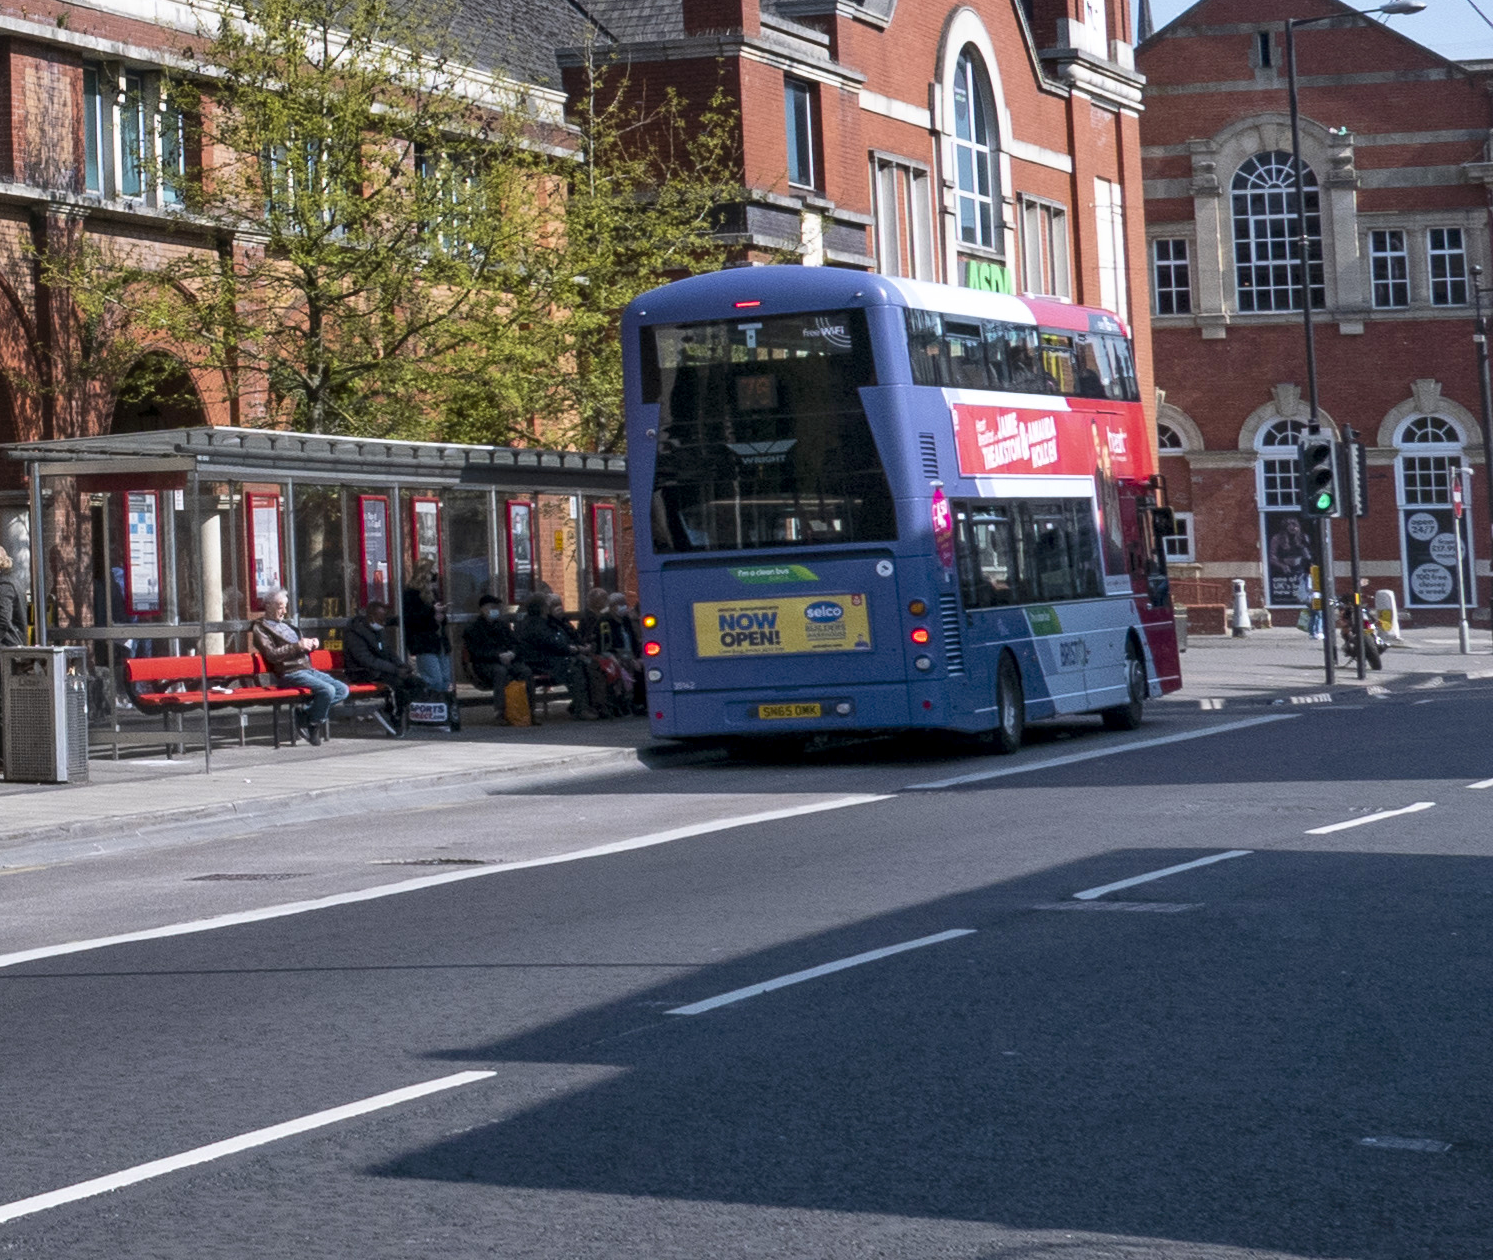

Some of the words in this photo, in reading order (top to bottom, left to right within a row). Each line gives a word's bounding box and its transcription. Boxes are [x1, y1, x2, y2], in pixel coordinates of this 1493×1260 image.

[1027, 416, 1057, 445] AMANDA
[718, 612, 778, 632] NOW
[806, 605, 842, 618] selco
[720, 630, 782, 648] OPEN!
[763, 706, 793, 717] SN65
